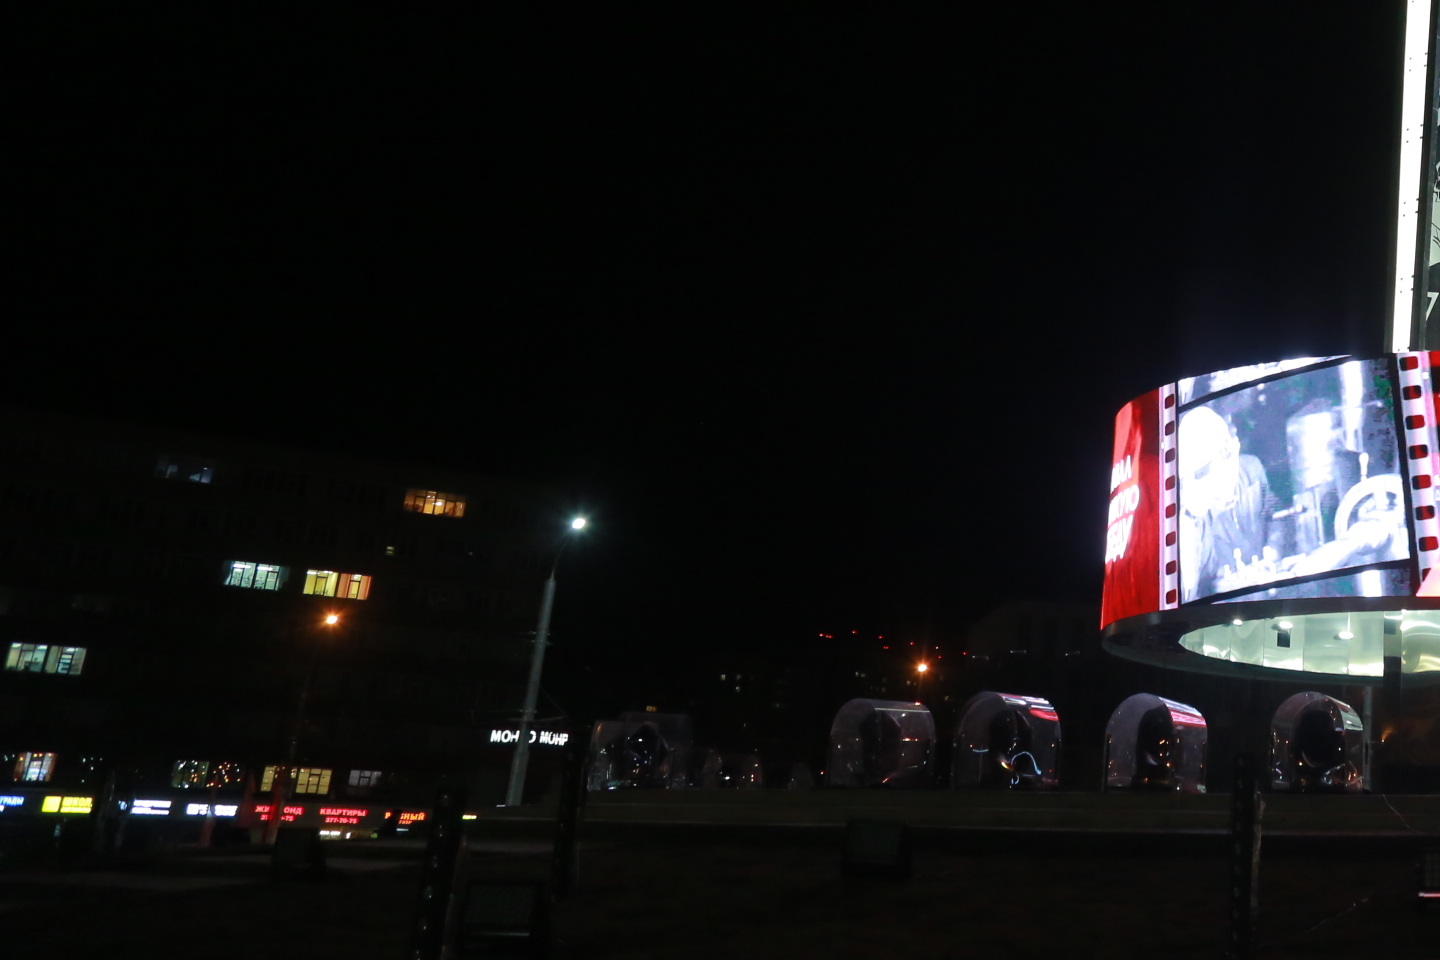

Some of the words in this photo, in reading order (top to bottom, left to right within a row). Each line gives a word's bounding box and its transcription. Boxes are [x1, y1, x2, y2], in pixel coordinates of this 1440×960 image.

[490, 729, 537, 744] МОНО
[62, 796, 93, 808] ШКОЛ
[319, 807, 367, 817] КВАРТИРЫ
